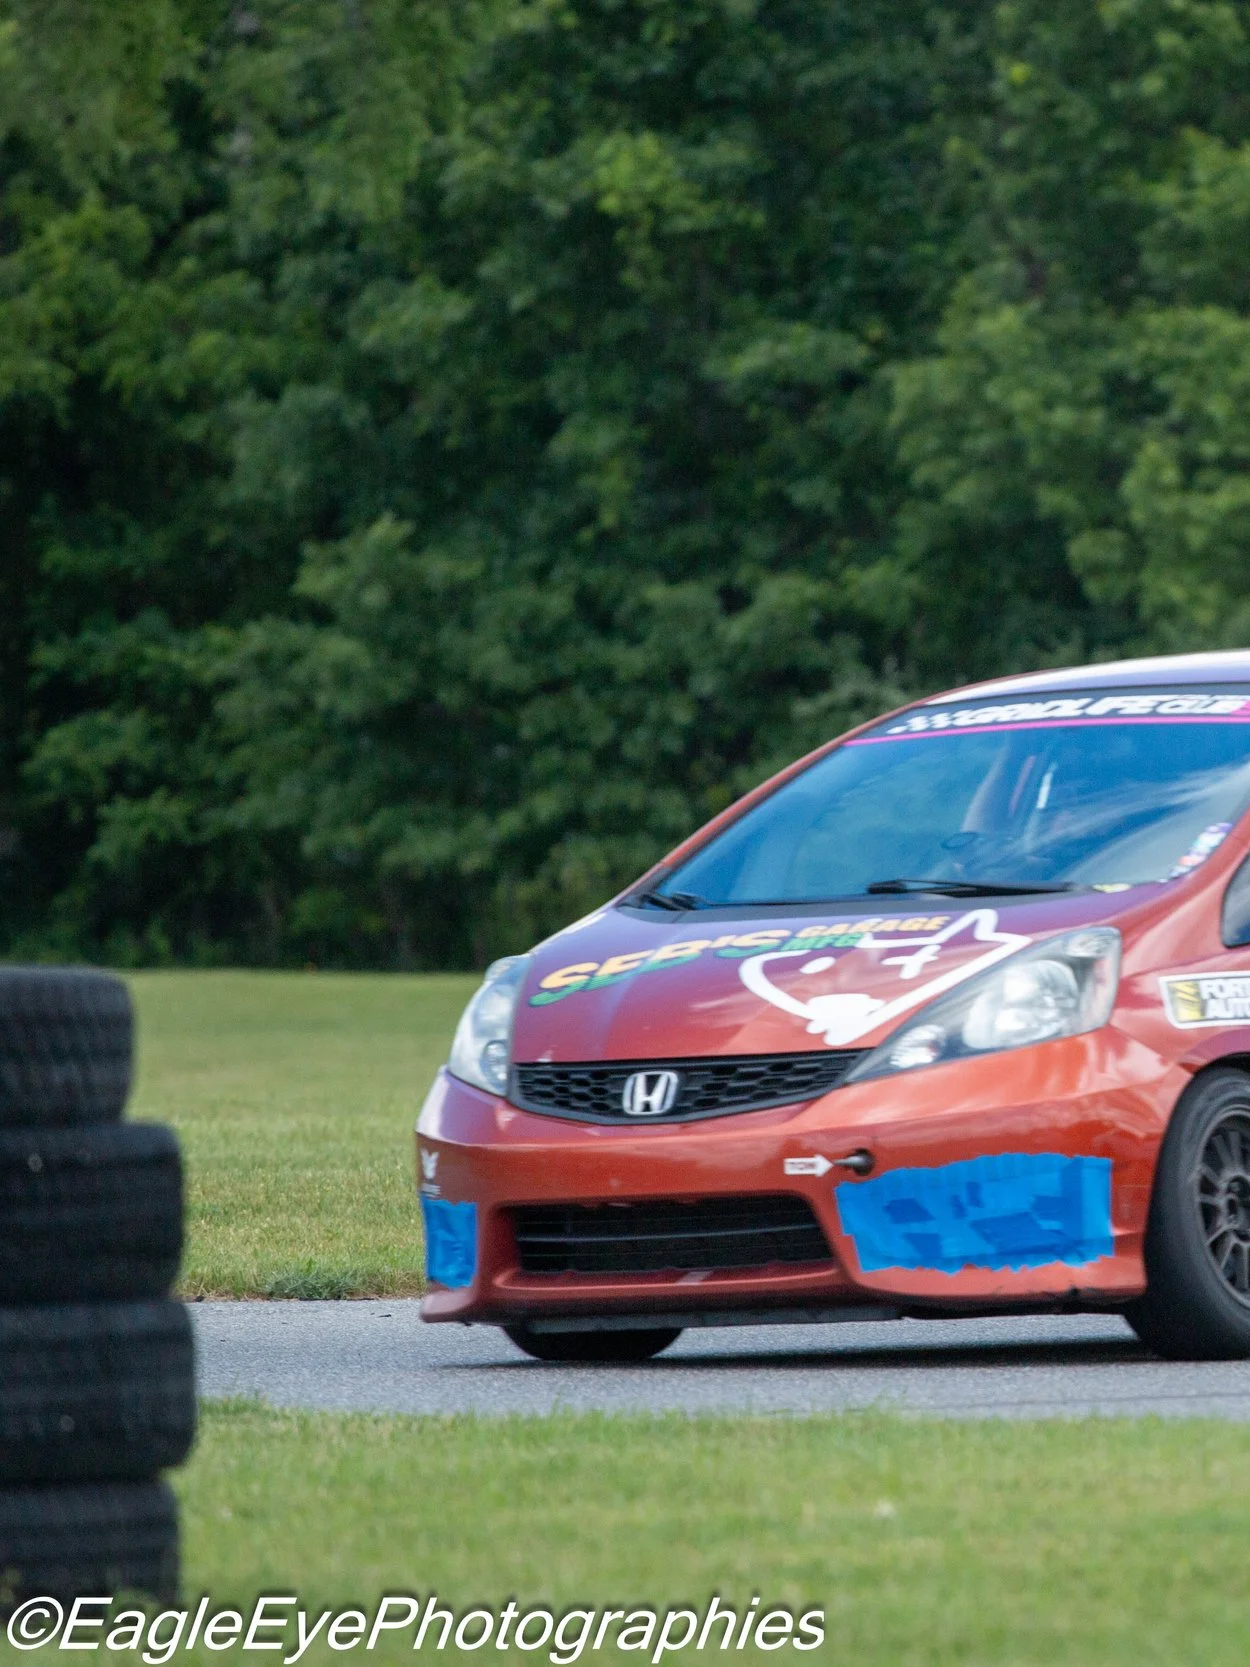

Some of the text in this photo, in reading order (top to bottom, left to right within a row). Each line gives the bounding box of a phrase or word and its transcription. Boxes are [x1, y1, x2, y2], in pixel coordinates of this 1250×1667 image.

[528, 915, 952, 1007] SEB'S GARAGE
[782, 932, 868, 952] MFG
